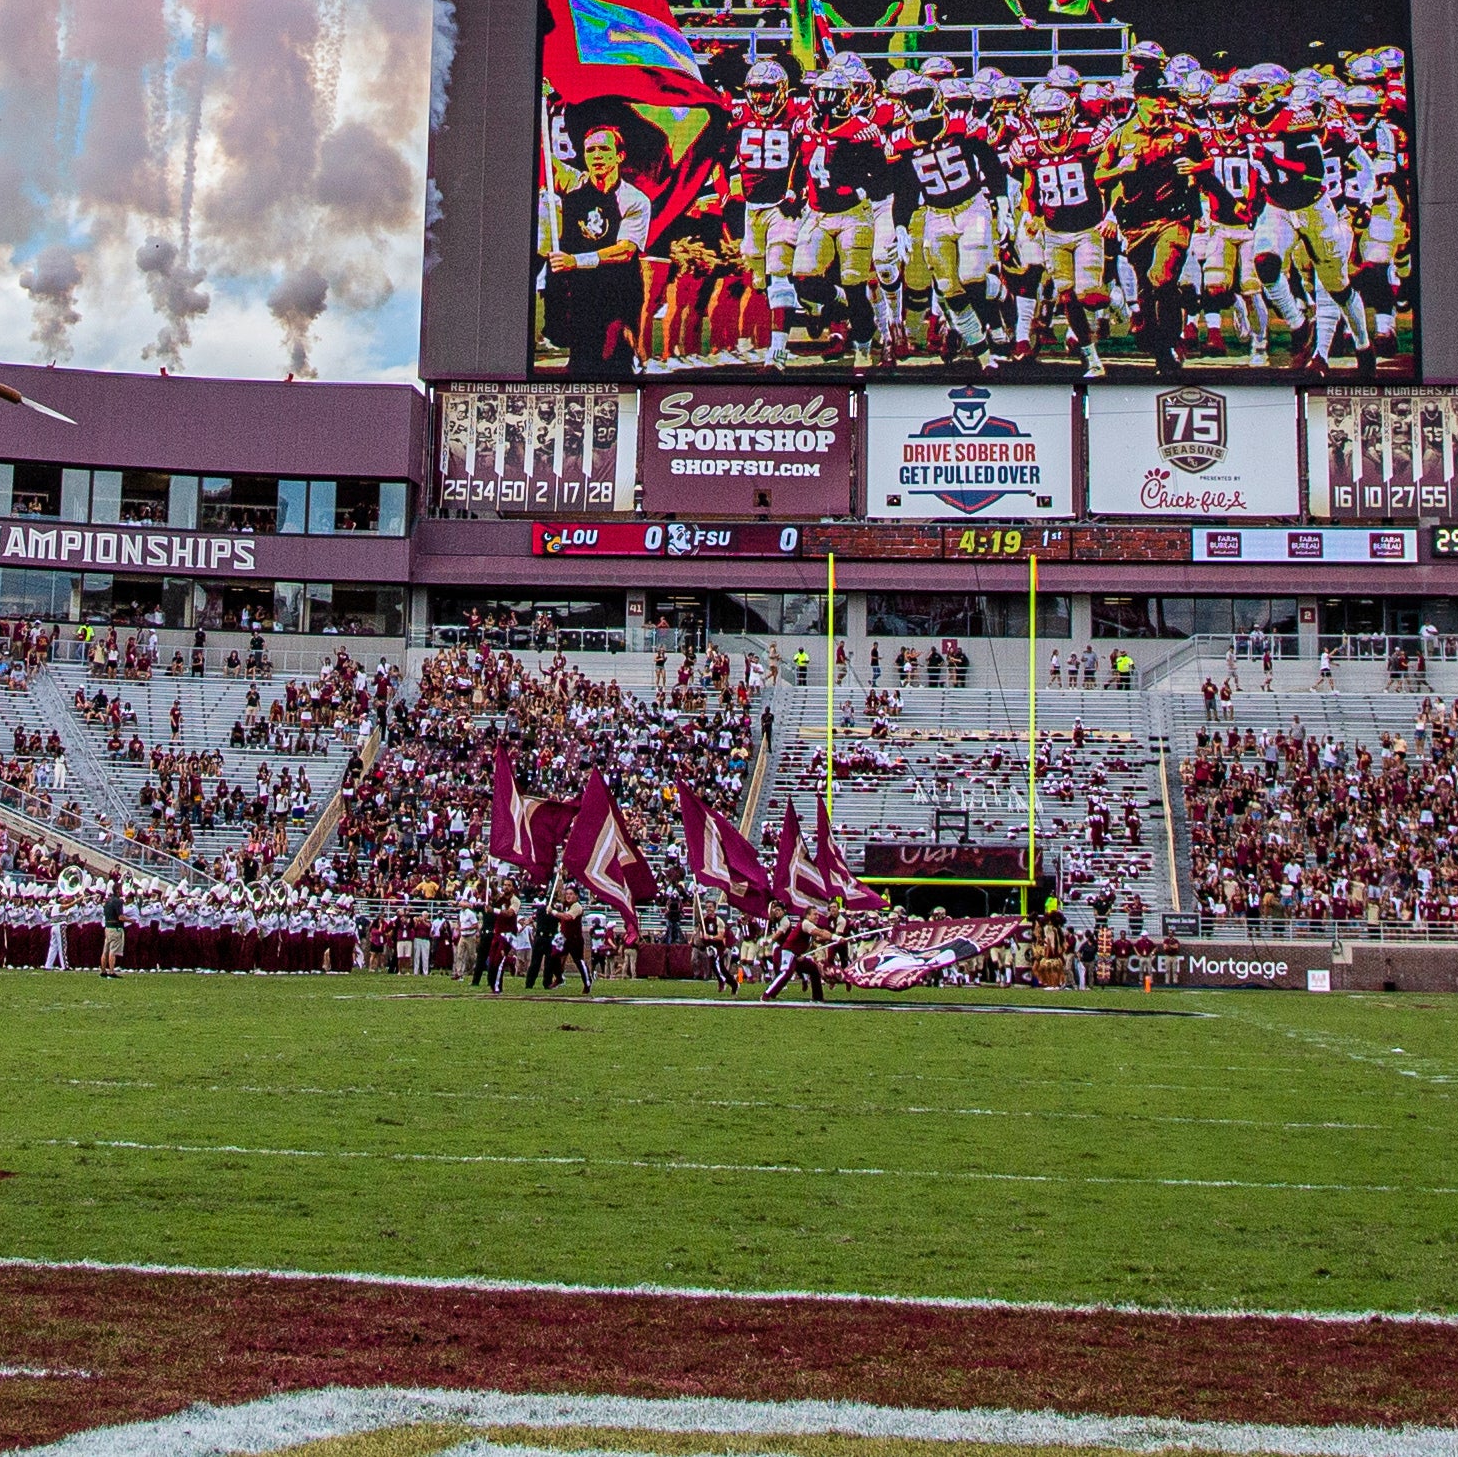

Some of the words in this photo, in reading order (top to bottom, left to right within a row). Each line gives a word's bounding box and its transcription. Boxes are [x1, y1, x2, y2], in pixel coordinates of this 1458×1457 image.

[741, 130, 790, 170] 58
[809, 144, 831, 189] 4
[912, 145, 971, 195] 55
[1037, 162, 1089, 208] 88
[450, 382, 499, 393] RETIRED
[505, 383, 620, 394] NUMBERS/JERSEYS
[1326, 387, 1378, 396] RETIRED
[655, 392, 839, 430] Seminole
[1165, 407, 1219, 441] 75
[658, 428, 836, 453] SPORTSHOP
[903, 443, 952, 463] DRIVE
[955, 443, 1010, 462] SOBER
[1013, 443, 1036, 462] OR
[1163, 444, 1224, 458] SEASONS
[670, 459, 821, 477] SHOPFSU.COM
[899, 466, 930, 485] GET
[933, 465, 994, 485] PULLED
[997, 465, 1041, 485] OVER
[443, 479, 468, 501] 25
[471, 480, 496, 502] 34
[501, 481, 525, 502] 50
[535, 481, 549, 503] 2
[563, 482, 581, 503] 17
[588, 482, 613, 503] 28
[1334, 486, 1353, 508] 16
[1364, 486, 1382, 508] 10
[1391, 486, 1416, 508] 27
[1421, 486, 1447, 508] 55
[561, 529, 598, 545] LOU
[644, 525, 663, 550] 0
[694, 530, 732, 546] FSU
[779, 527, 798, 552] 0
[958, 530, 1022, 554] 4:19
[1042, 528, 1062, 547] 1st
[630, 603, 643, 614] 41
[1304, 610, 1313, 620] 2
[1188, 955, 1289, 980] Mortgage
